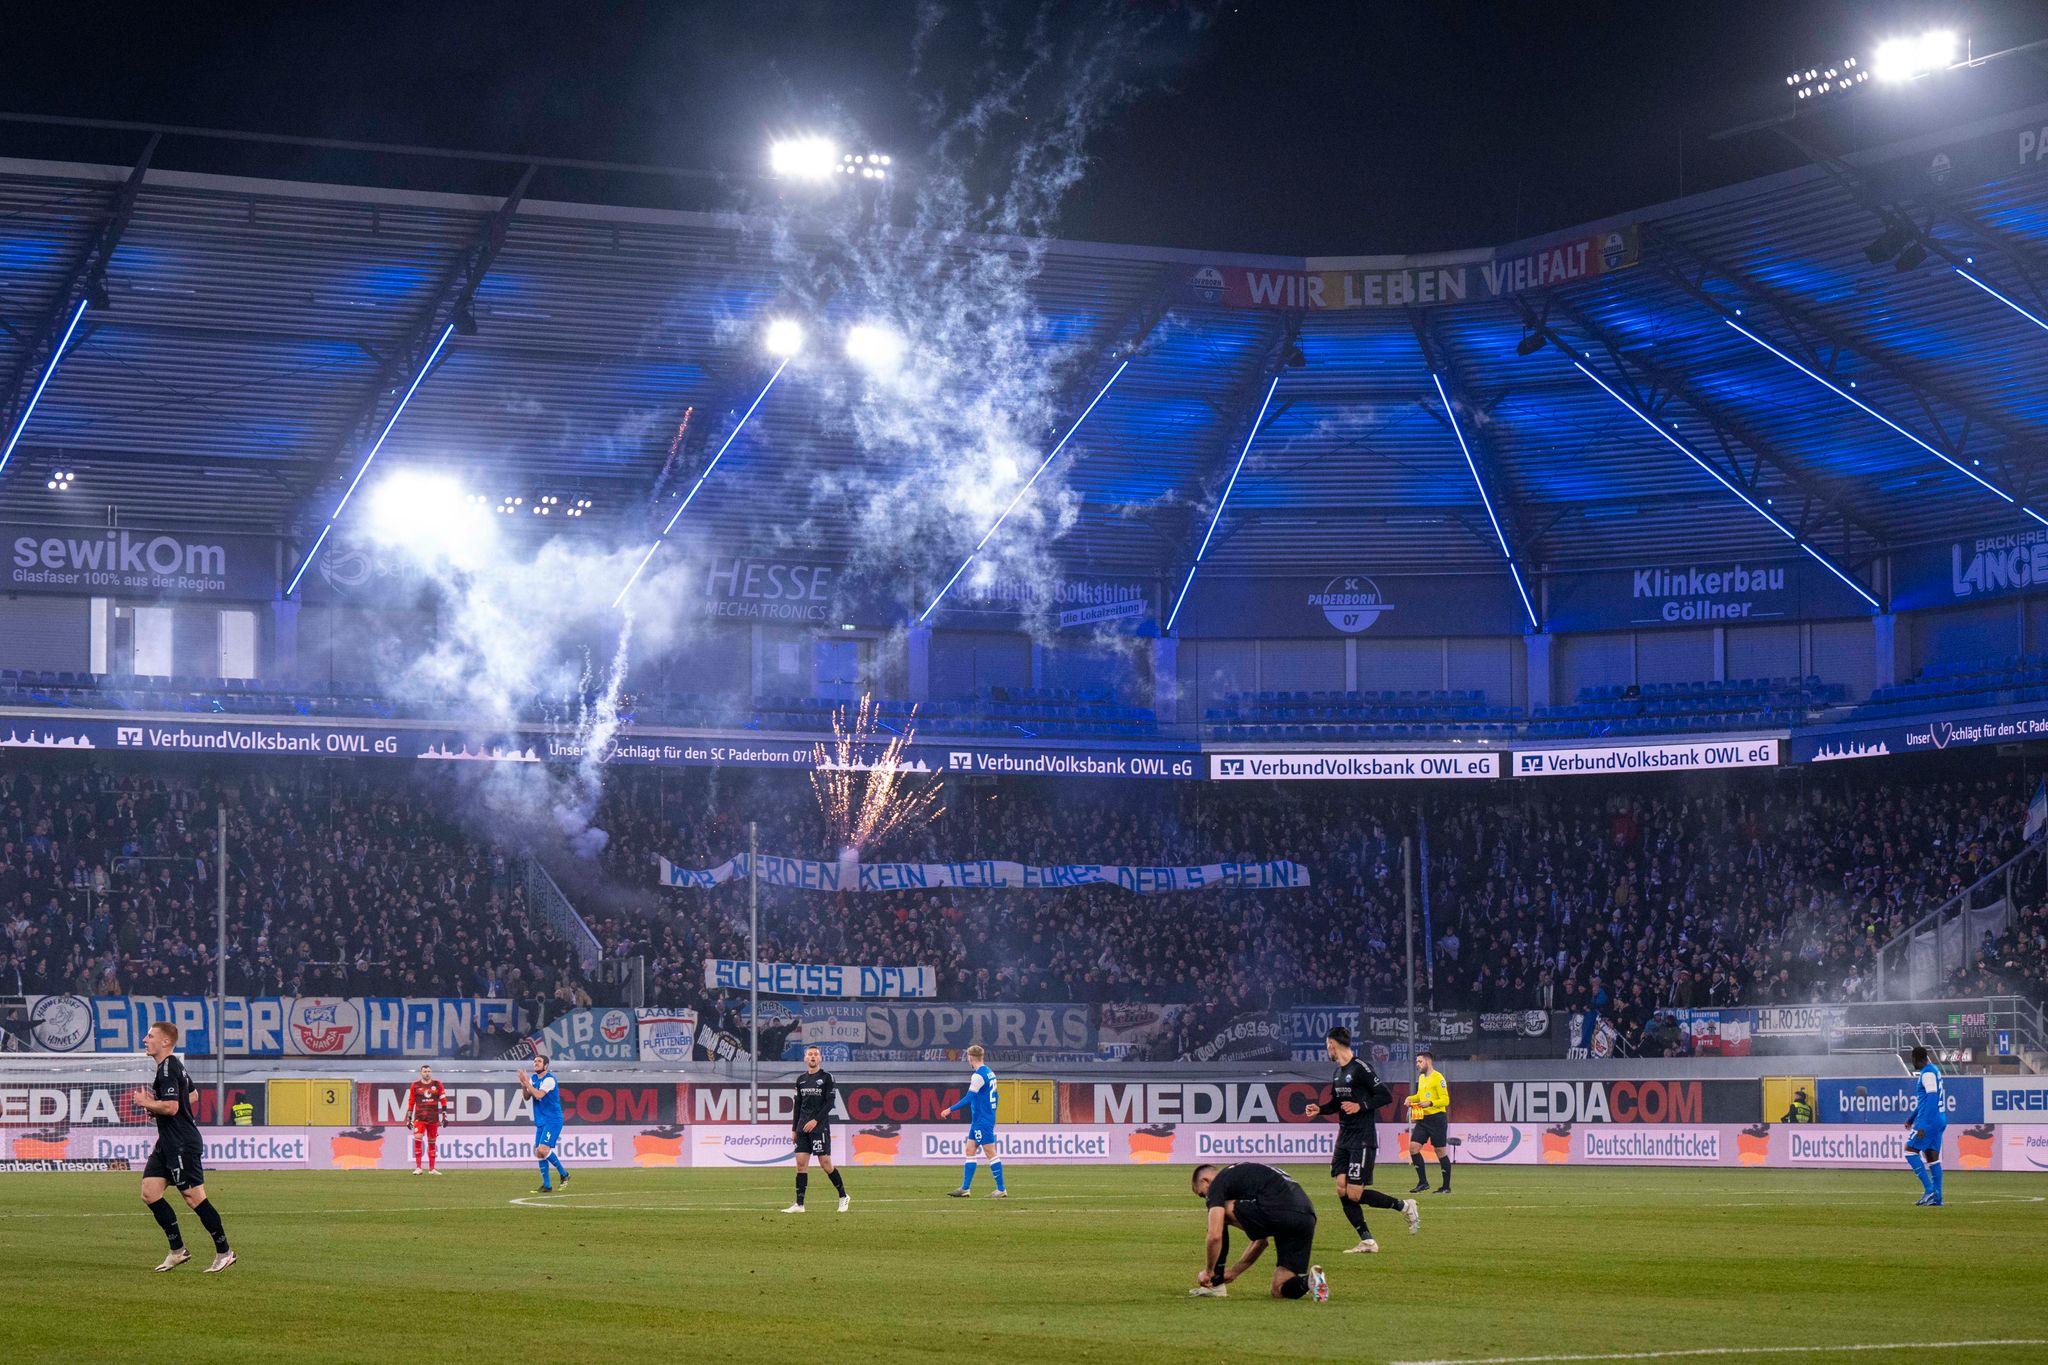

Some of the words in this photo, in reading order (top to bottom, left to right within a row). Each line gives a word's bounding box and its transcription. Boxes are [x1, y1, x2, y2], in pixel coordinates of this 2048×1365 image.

[1247, 271, 1327, 307] WIR
[1344, 267, 1467, 306] LEBEN
[1481, 241, 1590, 296] VIELFALT
[13, 532, 226, 575] sewikOm
[13, 568, 79, 585] Glasfaser
[83, 571, 120, 587] 100%
[124, 577, 149, 588] aus
[152, 573, 175, 589] der
[178, 575, 225, 591] Region
[706, 549, 831, 600] HESSE
[1345, 579, 1358, 590] SC
[1633, 564, 1784, 597] Klinkerbau
[1308, 593, 1376, 605] PADERBORN
[705, 601, 827, 620] MECHATRONICS
[1063, 613, 1078, 624] die
[1081, 603, 1140, 622] Lokalzeitung
[1343, 614, 1360, 626] 07
[1662, 600, 1752, 621] Göllner
[149, 728, 321, 751] VerbundVolksbank
[326, 733, 370, 753] OWL
[374, 736, 397, 753] eG
[1906, 732, 1930, 746] Unser
[1951, 726, 1982, 742] schlägt
[1983, 723, 1996, 737] für
[1998, 721, 2014, 736] den
[2016, 721, 2028, 734] SC
[549, 743, 585, 756] Unser
[616, 745, 661, 763] schlägt
[664, 746, 682, 760] für
[685, 747, 708, 760] den
[711, 748, 725, 761] SC
[729, 749, 789, 763] Paderborn
[793, 750, 812, 763] 07!
[1548, 751, 1699, 771] VerbundVolksbank
[1704, 747, 1744, 765] OWL
[1748, 745, 1769, 763] eG
[977, 753, 1126, 775] VerbundVolksbank
[1130, 758, 1168, 776] OWL
[1172, 759, 1192, 777] eG
[1250, 759, 1415, 776] VerbundVolksbank
[1421, 758, 1462, 775] OWL
[1468, 758, 1490, 775] eG
[858, 863, 928, 889] KEIN
[948, 859, 1007, 889] TEIL
[715, 959, 843, 996] SCHEISS
[860, 966, 925, 998] DFL!
[803, 1006, 863, 1018] SCHWERIN
[1757, 1009, 1771, 1030] HH
[1779, 1009, 1792, 1029] RO
[1794, 1008, 1821, 1029] 1965
[95, 999, 281, 1050] SUPER
[541, 1011, 594, 1056] NB
[830, 1026, 860, 1037] TOUR
[866, 1003, 1088, 1050] SUPTRAS
[580, 1043, 632, 1058] TOUR
[1390, 1042, 1432, 1054] REUERS'
[1999, 1034, 2009, 1052] H
[0, 1088, 246, 1123] EDIACM
[326, 1089, 335, 1105] 3
[696, 1087, 962, 1122] MEDCOM
[1031, 1088, 1040, 1104] 4
[1493, 1082, 1703, 1123] MEDIACOM
[1991, 1090, 2048, 1111] BRE
[98, 1136, 304, 1161] Deutandticket
[412, 1136, 608, 1159] eutschlanicket
[724, 1134, 796, 1149] PaderSprinte
[1199, 1132, 1333, 1154] Deutschlandti
[1467, 1132, 1510, 1147] PaderSprinter
[1587, 1132, 1716, 1158] Deutschlandticket
[1792, 1133, 1902, 1160] Deutschlandti
[1347, 1162, 1361, 1178] 23
